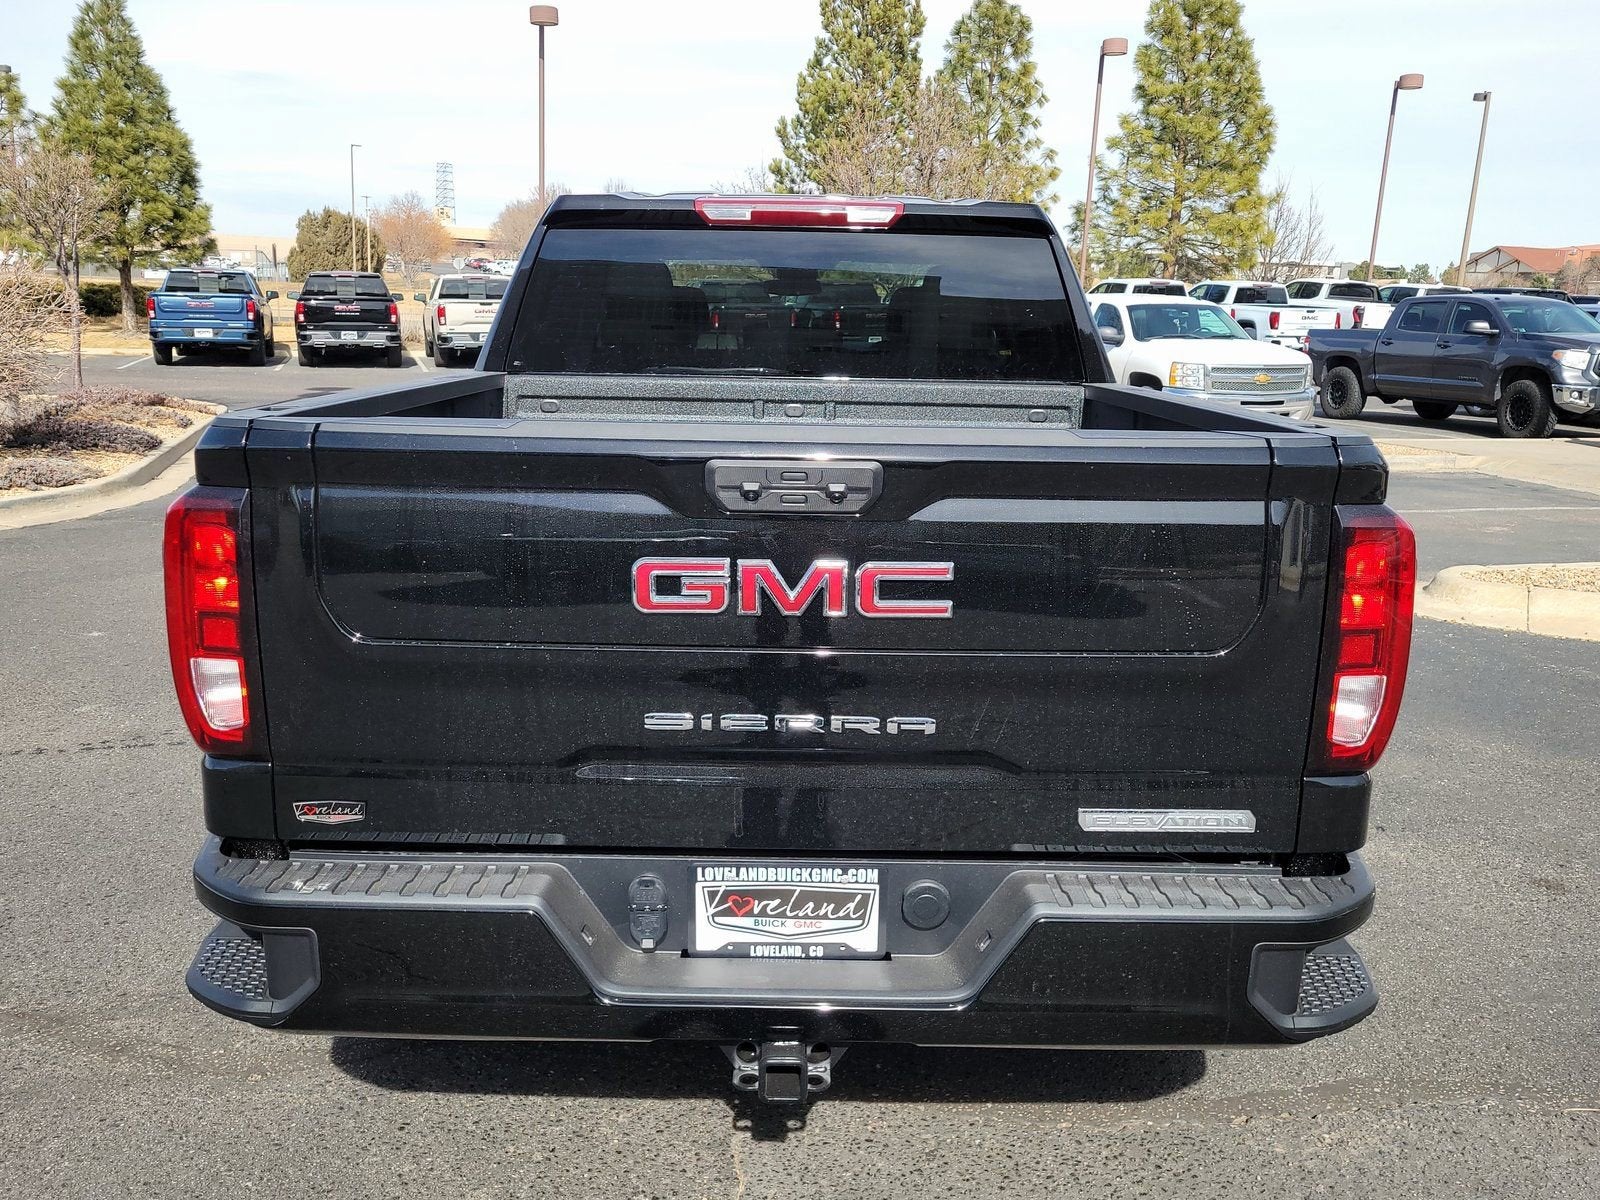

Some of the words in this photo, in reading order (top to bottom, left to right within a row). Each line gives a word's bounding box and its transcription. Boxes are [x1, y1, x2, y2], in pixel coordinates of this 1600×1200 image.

[632, 556, 955, 619] GMC
[643, 711, 937, 735] SIERRA
[1092, 813, 1249, 827] ELEVATION
[753, 919, 787, 928] BUICK
[793, 920, 823, 929] GMC
[750, 945, 806, 958] LOVELAND,
[808, 946, 825, 958] CO
